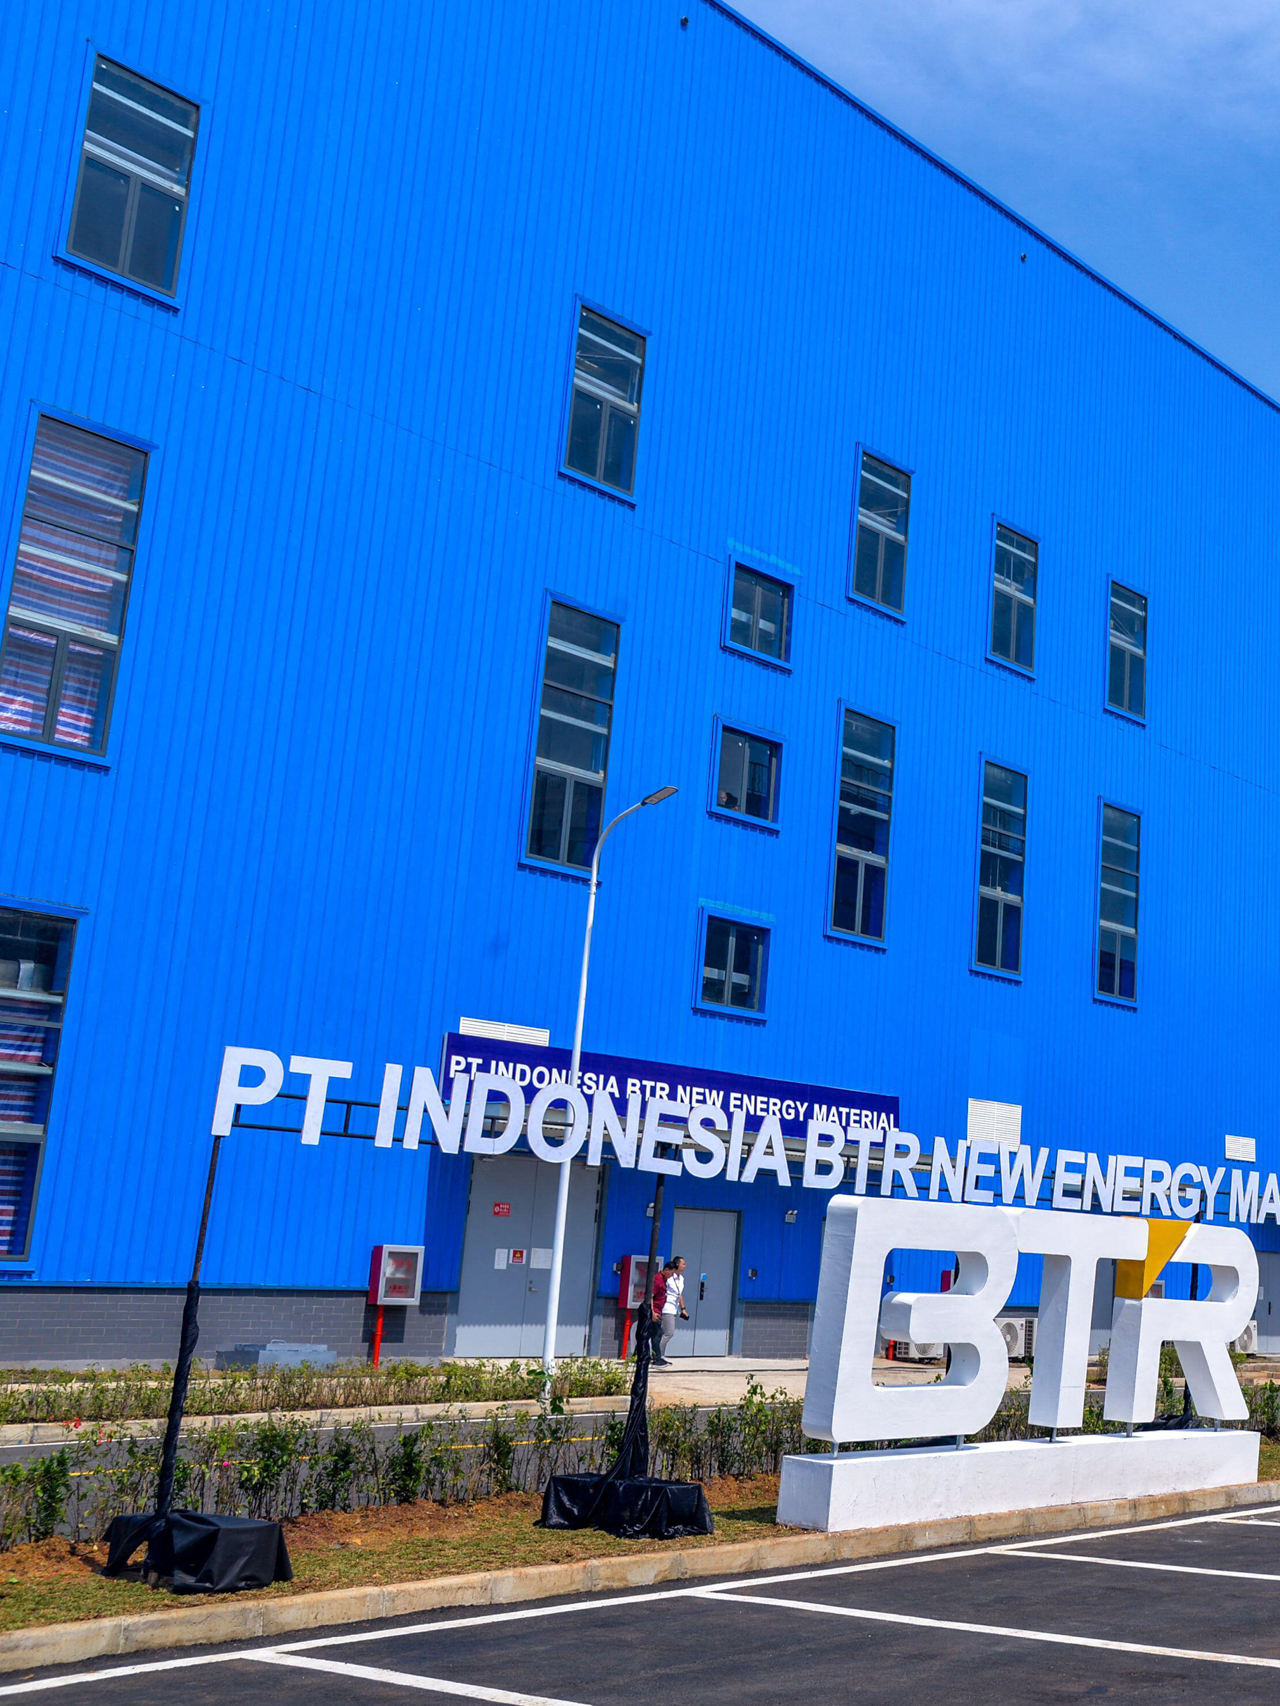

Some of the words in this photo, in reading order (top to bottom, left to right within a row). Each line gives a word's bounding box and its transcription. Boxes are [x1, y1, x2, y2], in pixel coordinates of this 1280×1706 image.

[211, 1046, 353, 1146] PT
[374, 1063, 791, 1186] INDONESIA
[803, 1119, 920, 1198] BTR
[929, 1137, 1049, 1206] NEW
[1052, 1149, 1226, 1219] ENERGY
[449, 1055, 483, 1080] PT
[626, 1078, 670, 1100] BTR
[677, 1085, 724, 1108] NEW
[729, 1093, 808, 1121] ENERGY
[813, 1104, 899, 1132] MATERIAL
[802, 1194, 1259, 1442] BTR
